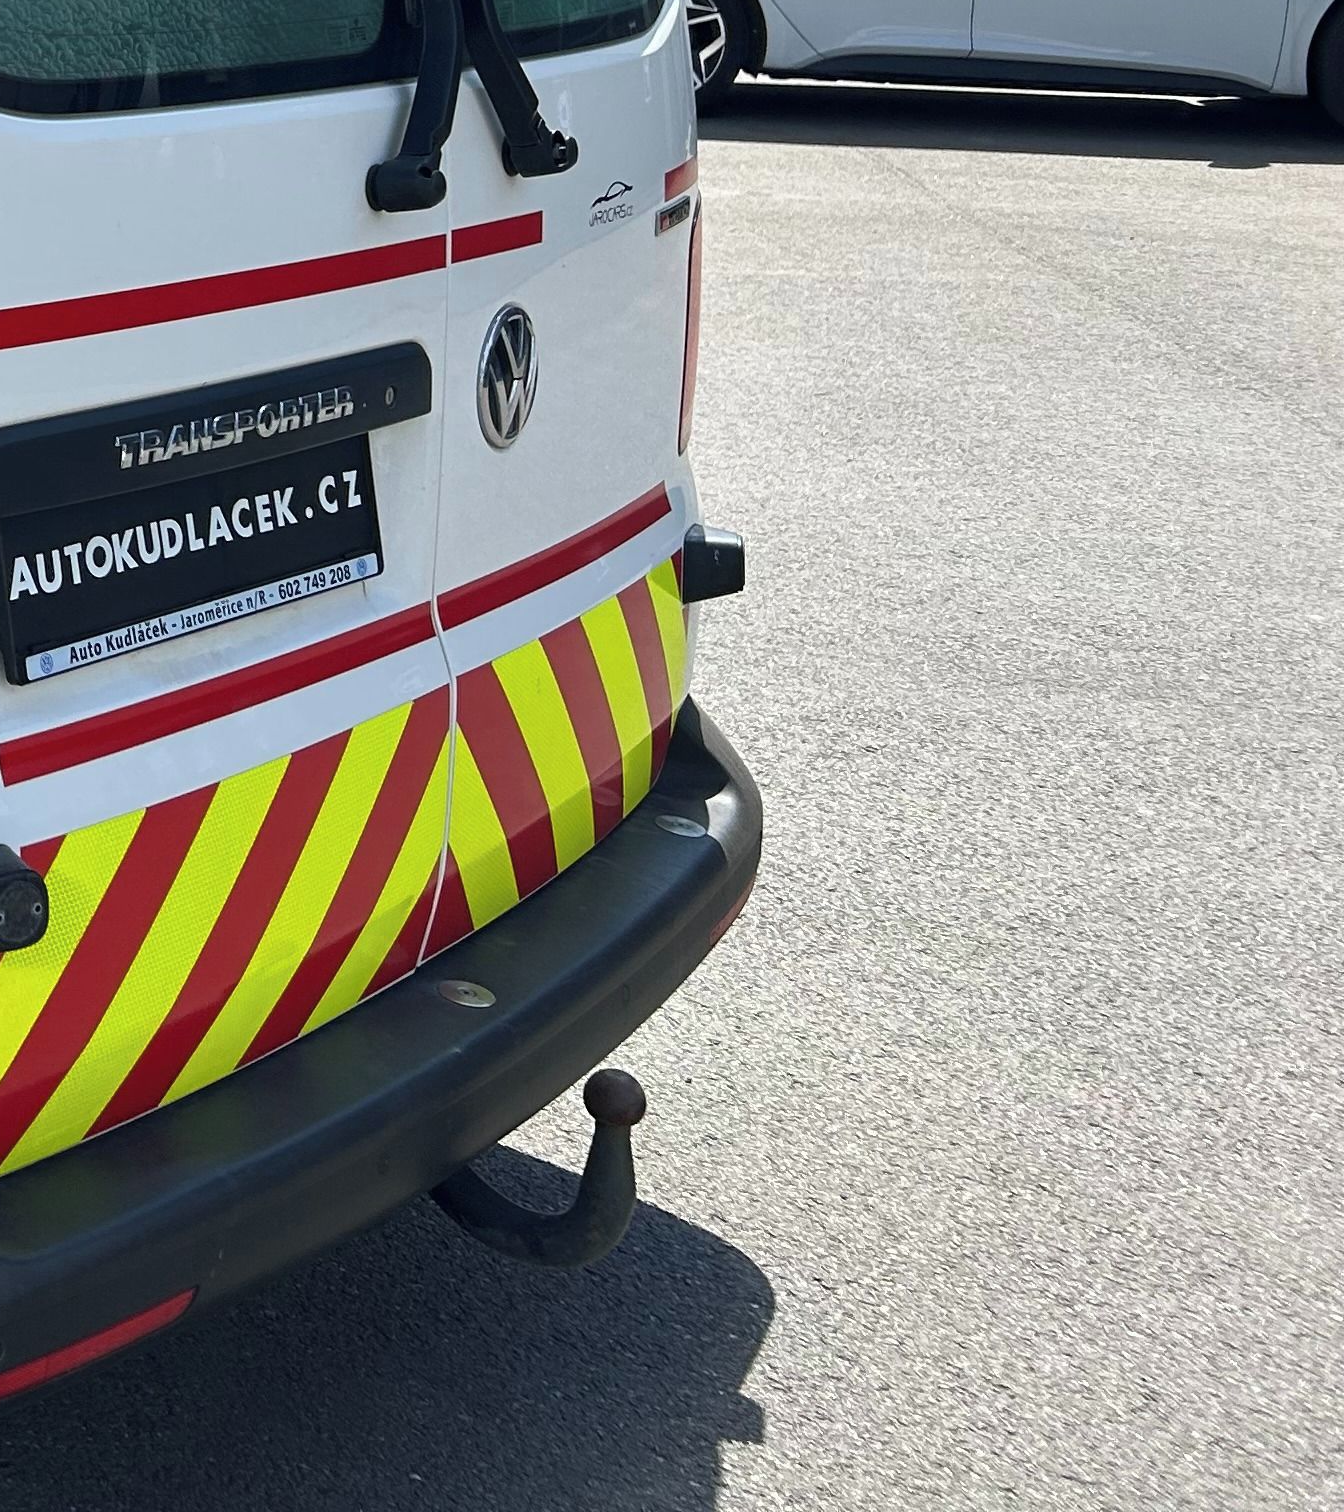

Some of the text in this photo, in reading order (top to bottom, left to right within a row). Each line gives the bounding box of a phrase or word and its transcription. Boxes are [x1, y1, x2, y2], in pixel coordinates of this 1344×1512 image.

[114, 385, 354, 470] TRANSPORTER
[69, 641, 102, 665] Auto
[105, 618, 169, 652] Kudláček
[180, 599, 244, 630] Jaroměřice
[246, 589, 268, 611] n/R
[278, 580, 302, 600] 602
[304, 572, 326, 594] 749
[328, 564, 351, 586] 208
